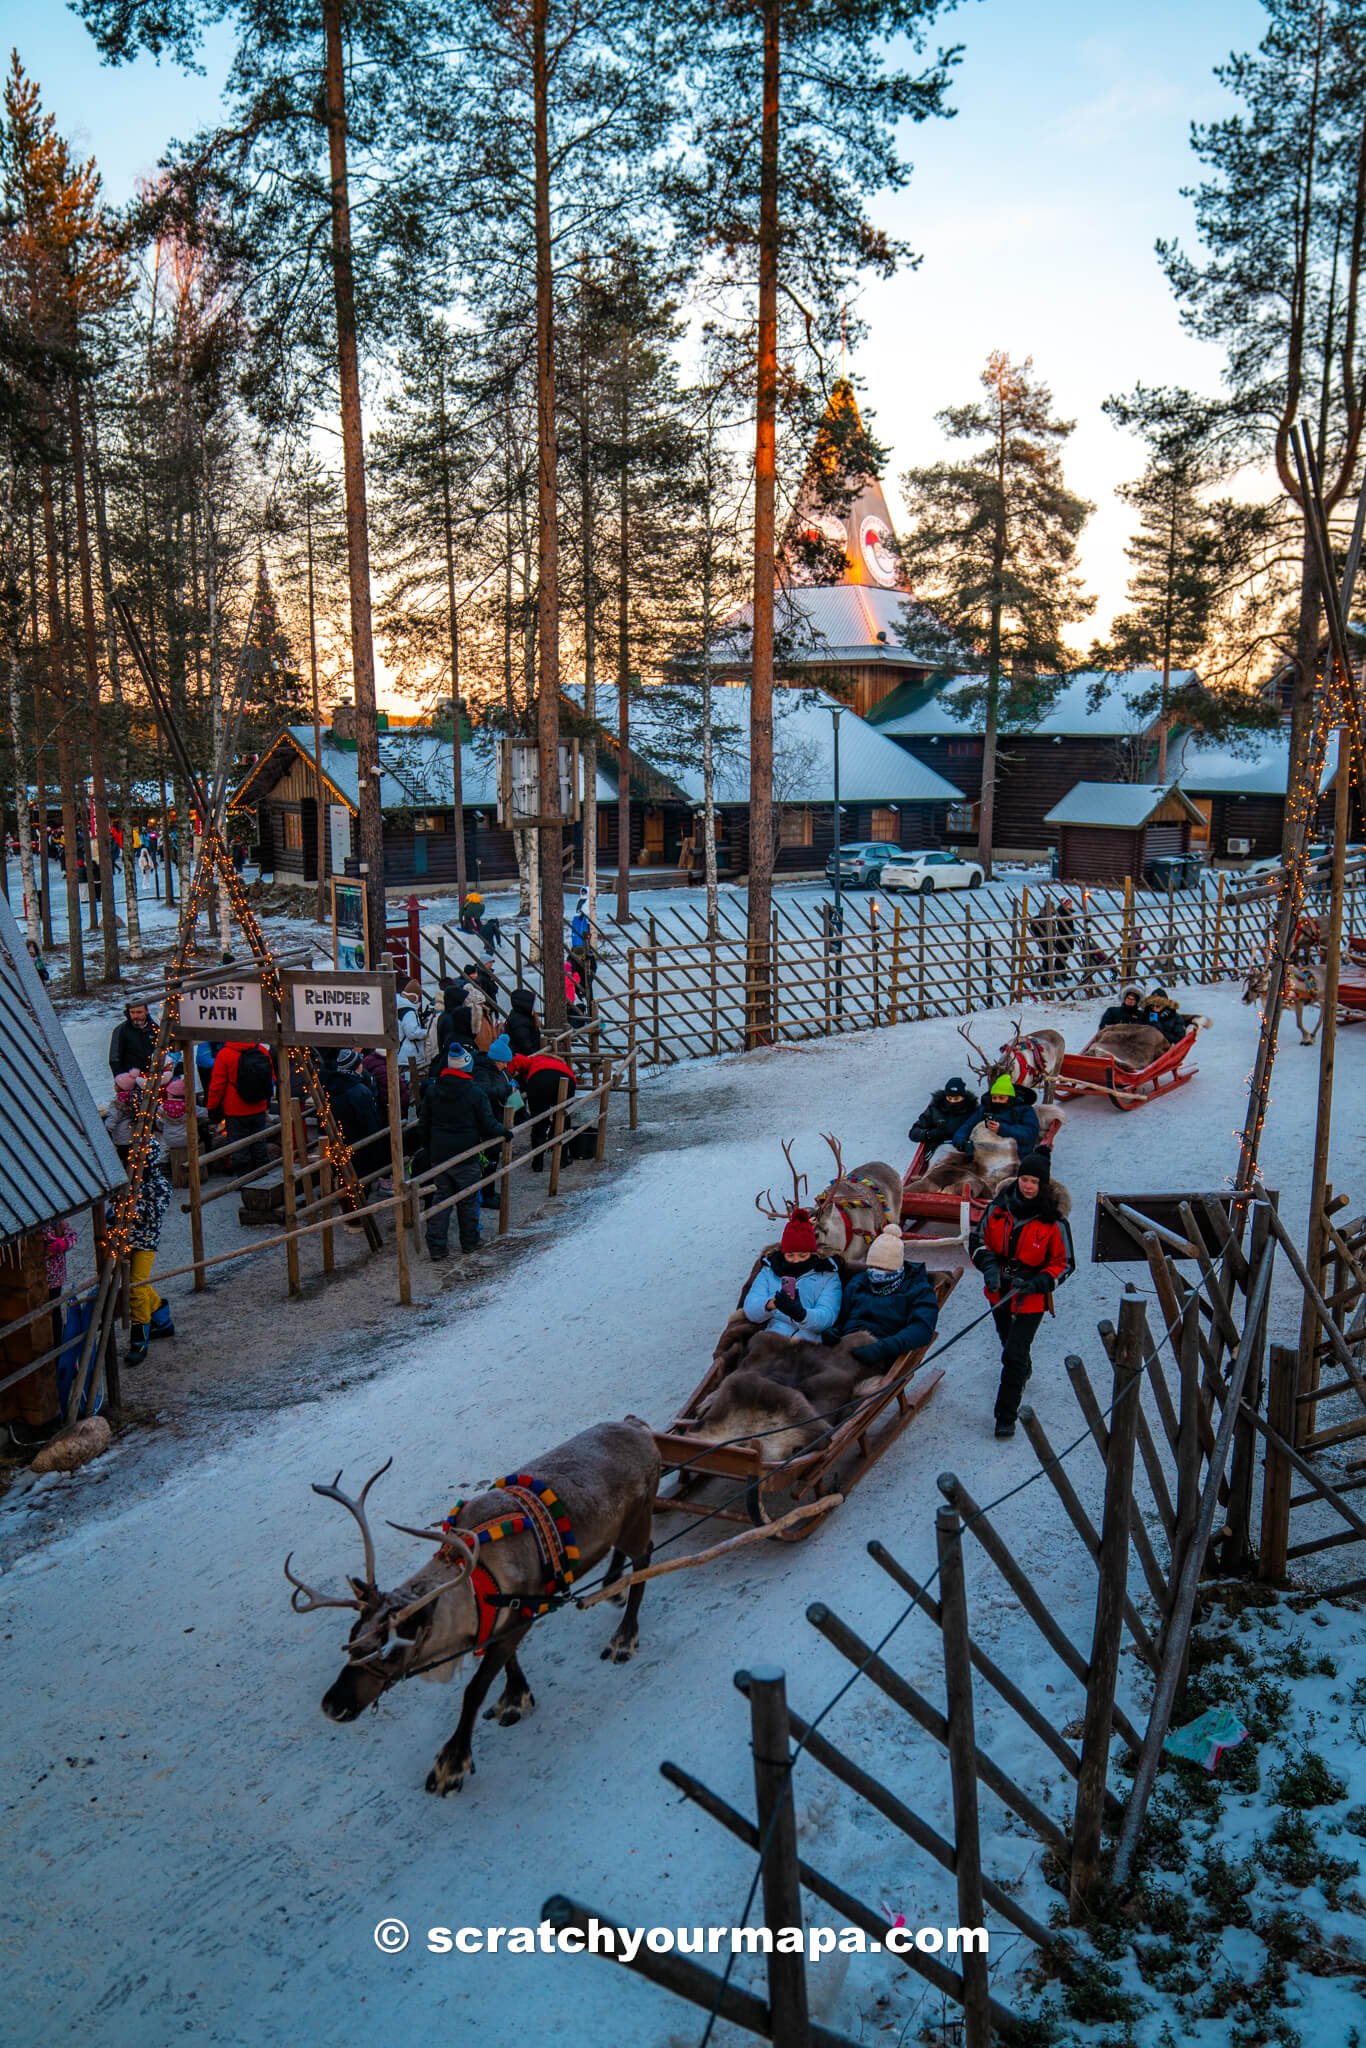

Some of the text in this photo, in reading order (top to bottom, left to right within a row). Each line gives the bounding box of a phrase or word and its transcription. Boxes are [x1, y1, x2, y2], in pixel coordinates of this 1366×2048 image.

[304, 988, 370, 1005] REINDEER
[199, 1005, 237, 1021] PATH
[314, 1010, 352, 1027] PATH
